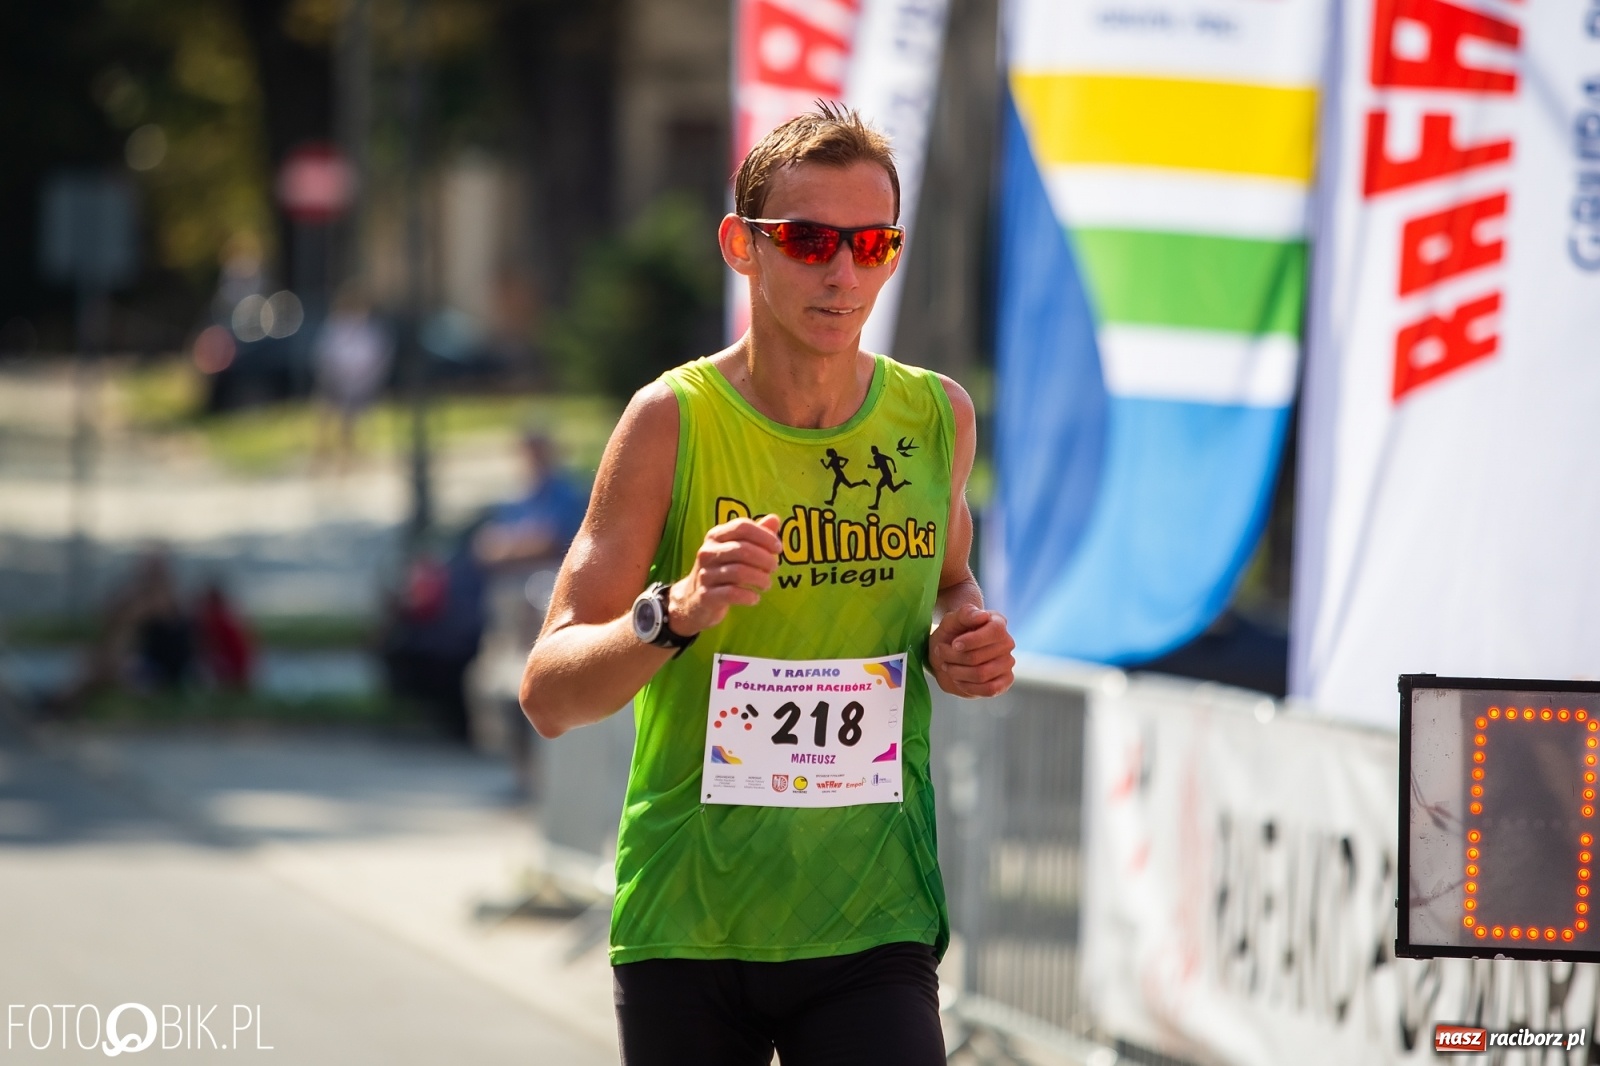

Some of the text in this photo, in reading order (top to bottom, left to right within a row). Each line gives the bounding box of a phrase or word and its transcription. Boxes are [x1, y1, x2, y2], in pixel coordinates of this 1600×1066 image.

[1363, 0, 1524, 406] RAFA
[715, 497, 936, 565] dlinioki
[777, 566, 894, 589] w biegu
[772, 668, 841, 678] V RAFAKO
[734, 681, 873, 693] PÓŁMARATON RACIBÓRZ
[771, 700, 865, 748] 218
[791, 753, 837, 765] MATEUSZ
